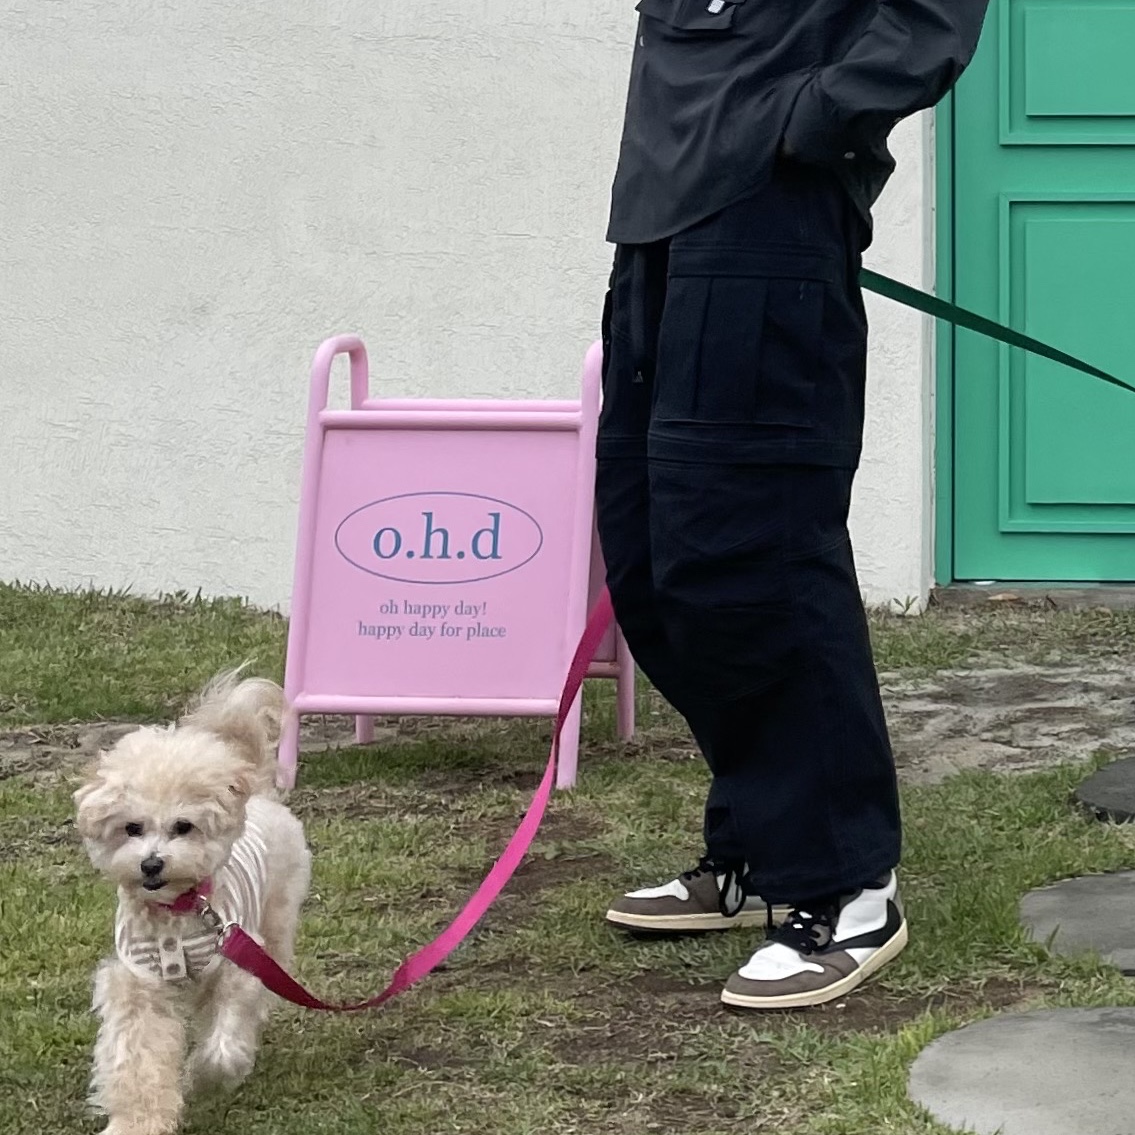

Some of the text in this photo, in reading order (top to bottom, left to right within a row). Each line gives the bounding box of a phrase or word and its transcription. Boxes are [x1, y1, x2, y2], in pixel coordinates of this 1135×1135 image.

[373, 511, 503, 560] o.h.d
[379, 599, 488, 620] oh happy day!
[358, 621, 507, 641] happy day for place
